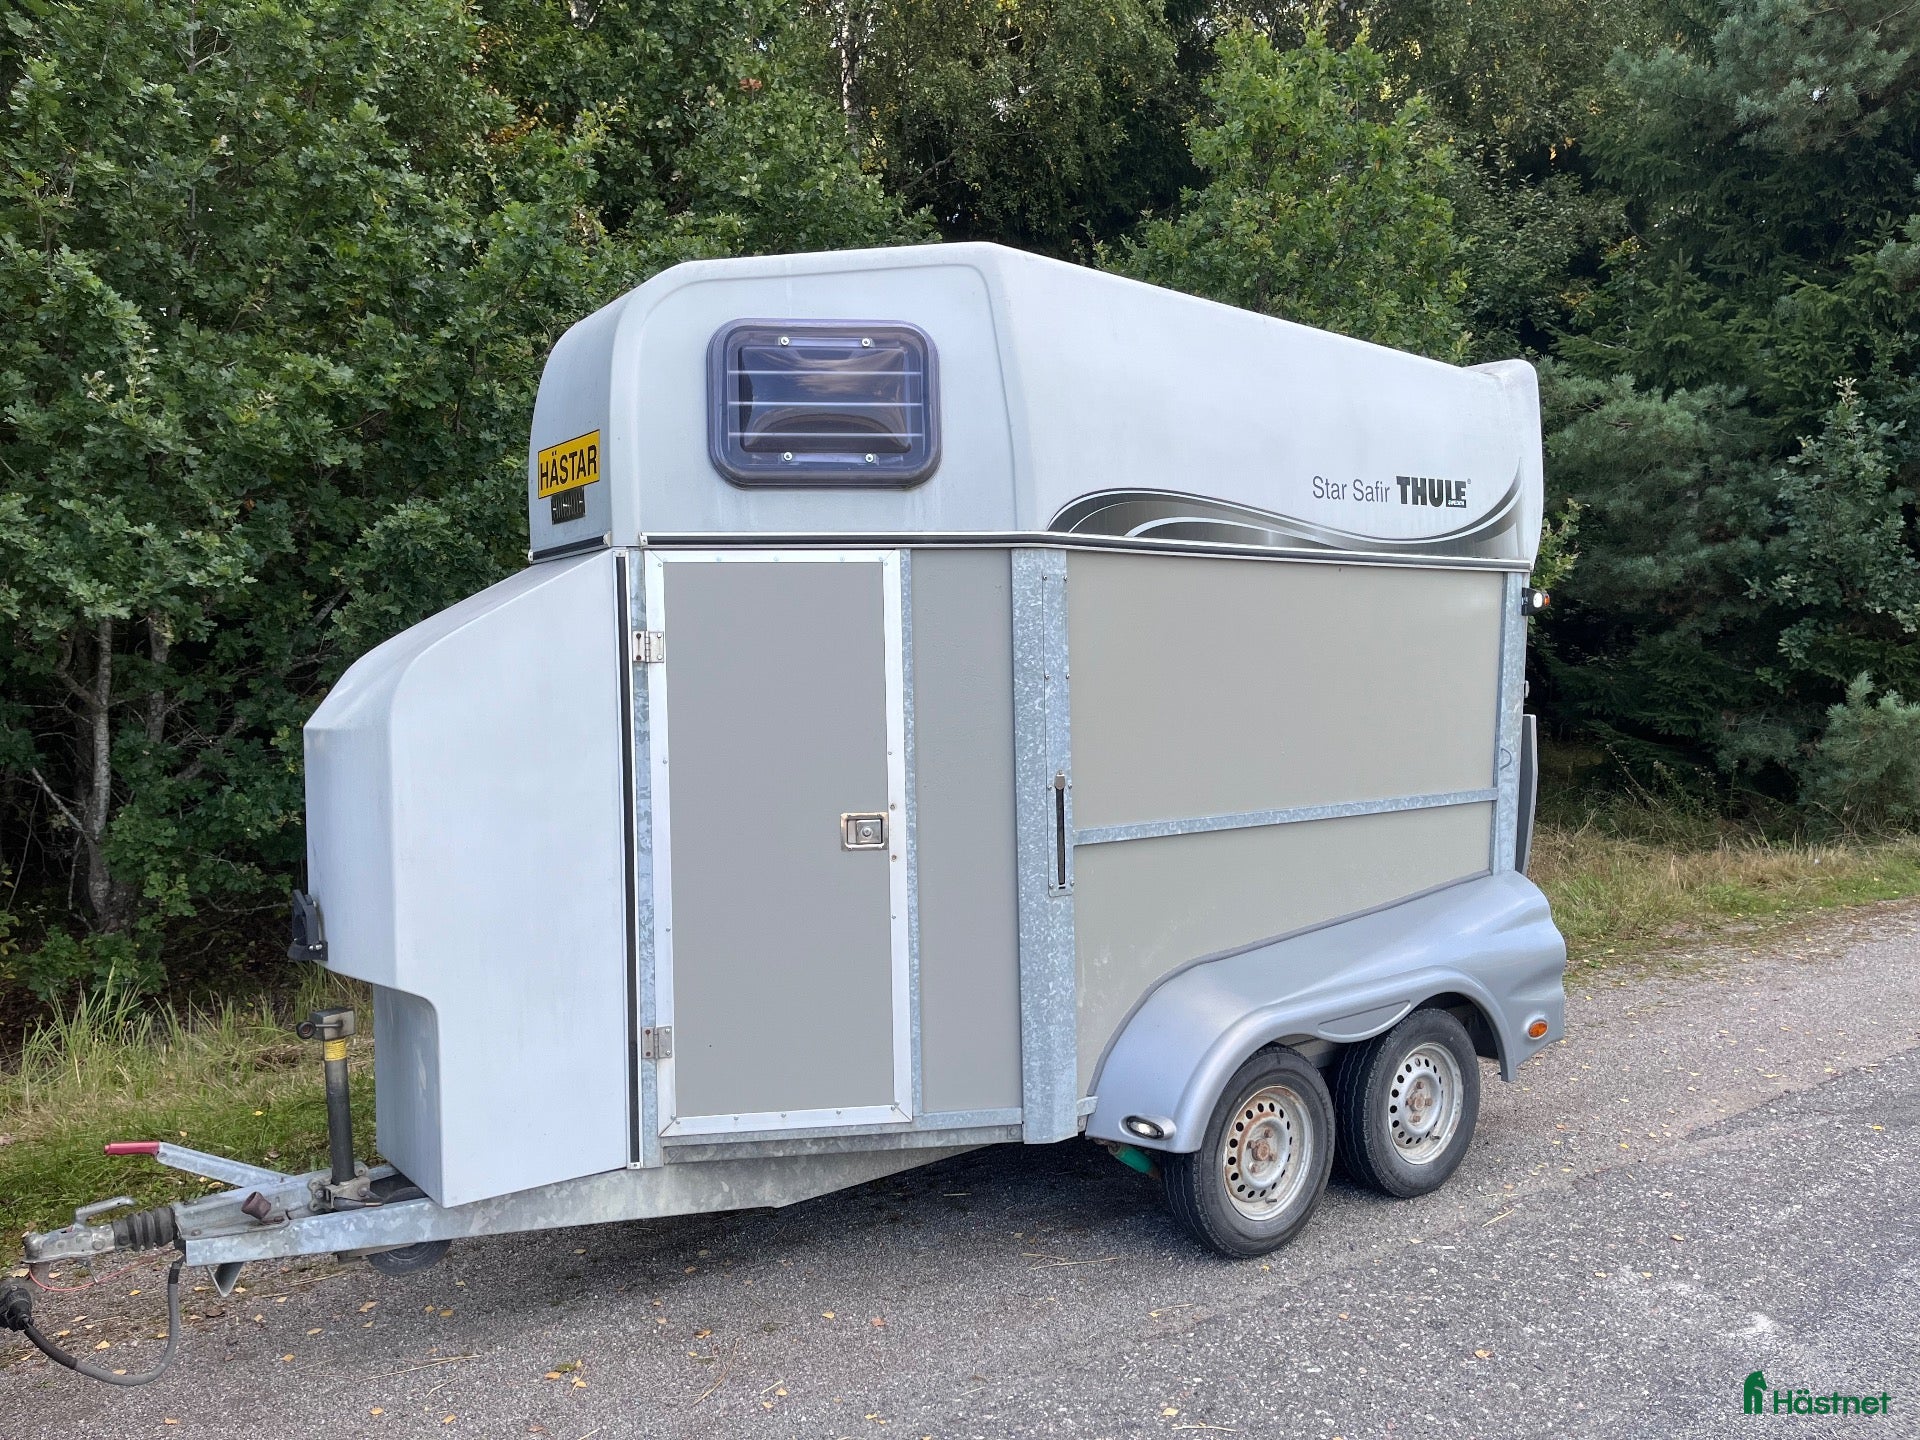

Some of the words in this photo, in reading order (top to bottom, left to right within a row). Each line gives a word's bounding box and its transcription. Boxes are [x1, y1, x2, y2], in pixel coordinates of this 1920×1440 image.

[540, 445, 597, 490] HÄSTAR
[1312, 475, 1347, 500] Star
[1353, 478, 1390, 503] Safir
[1396, 475, 1467, 508] THULE
